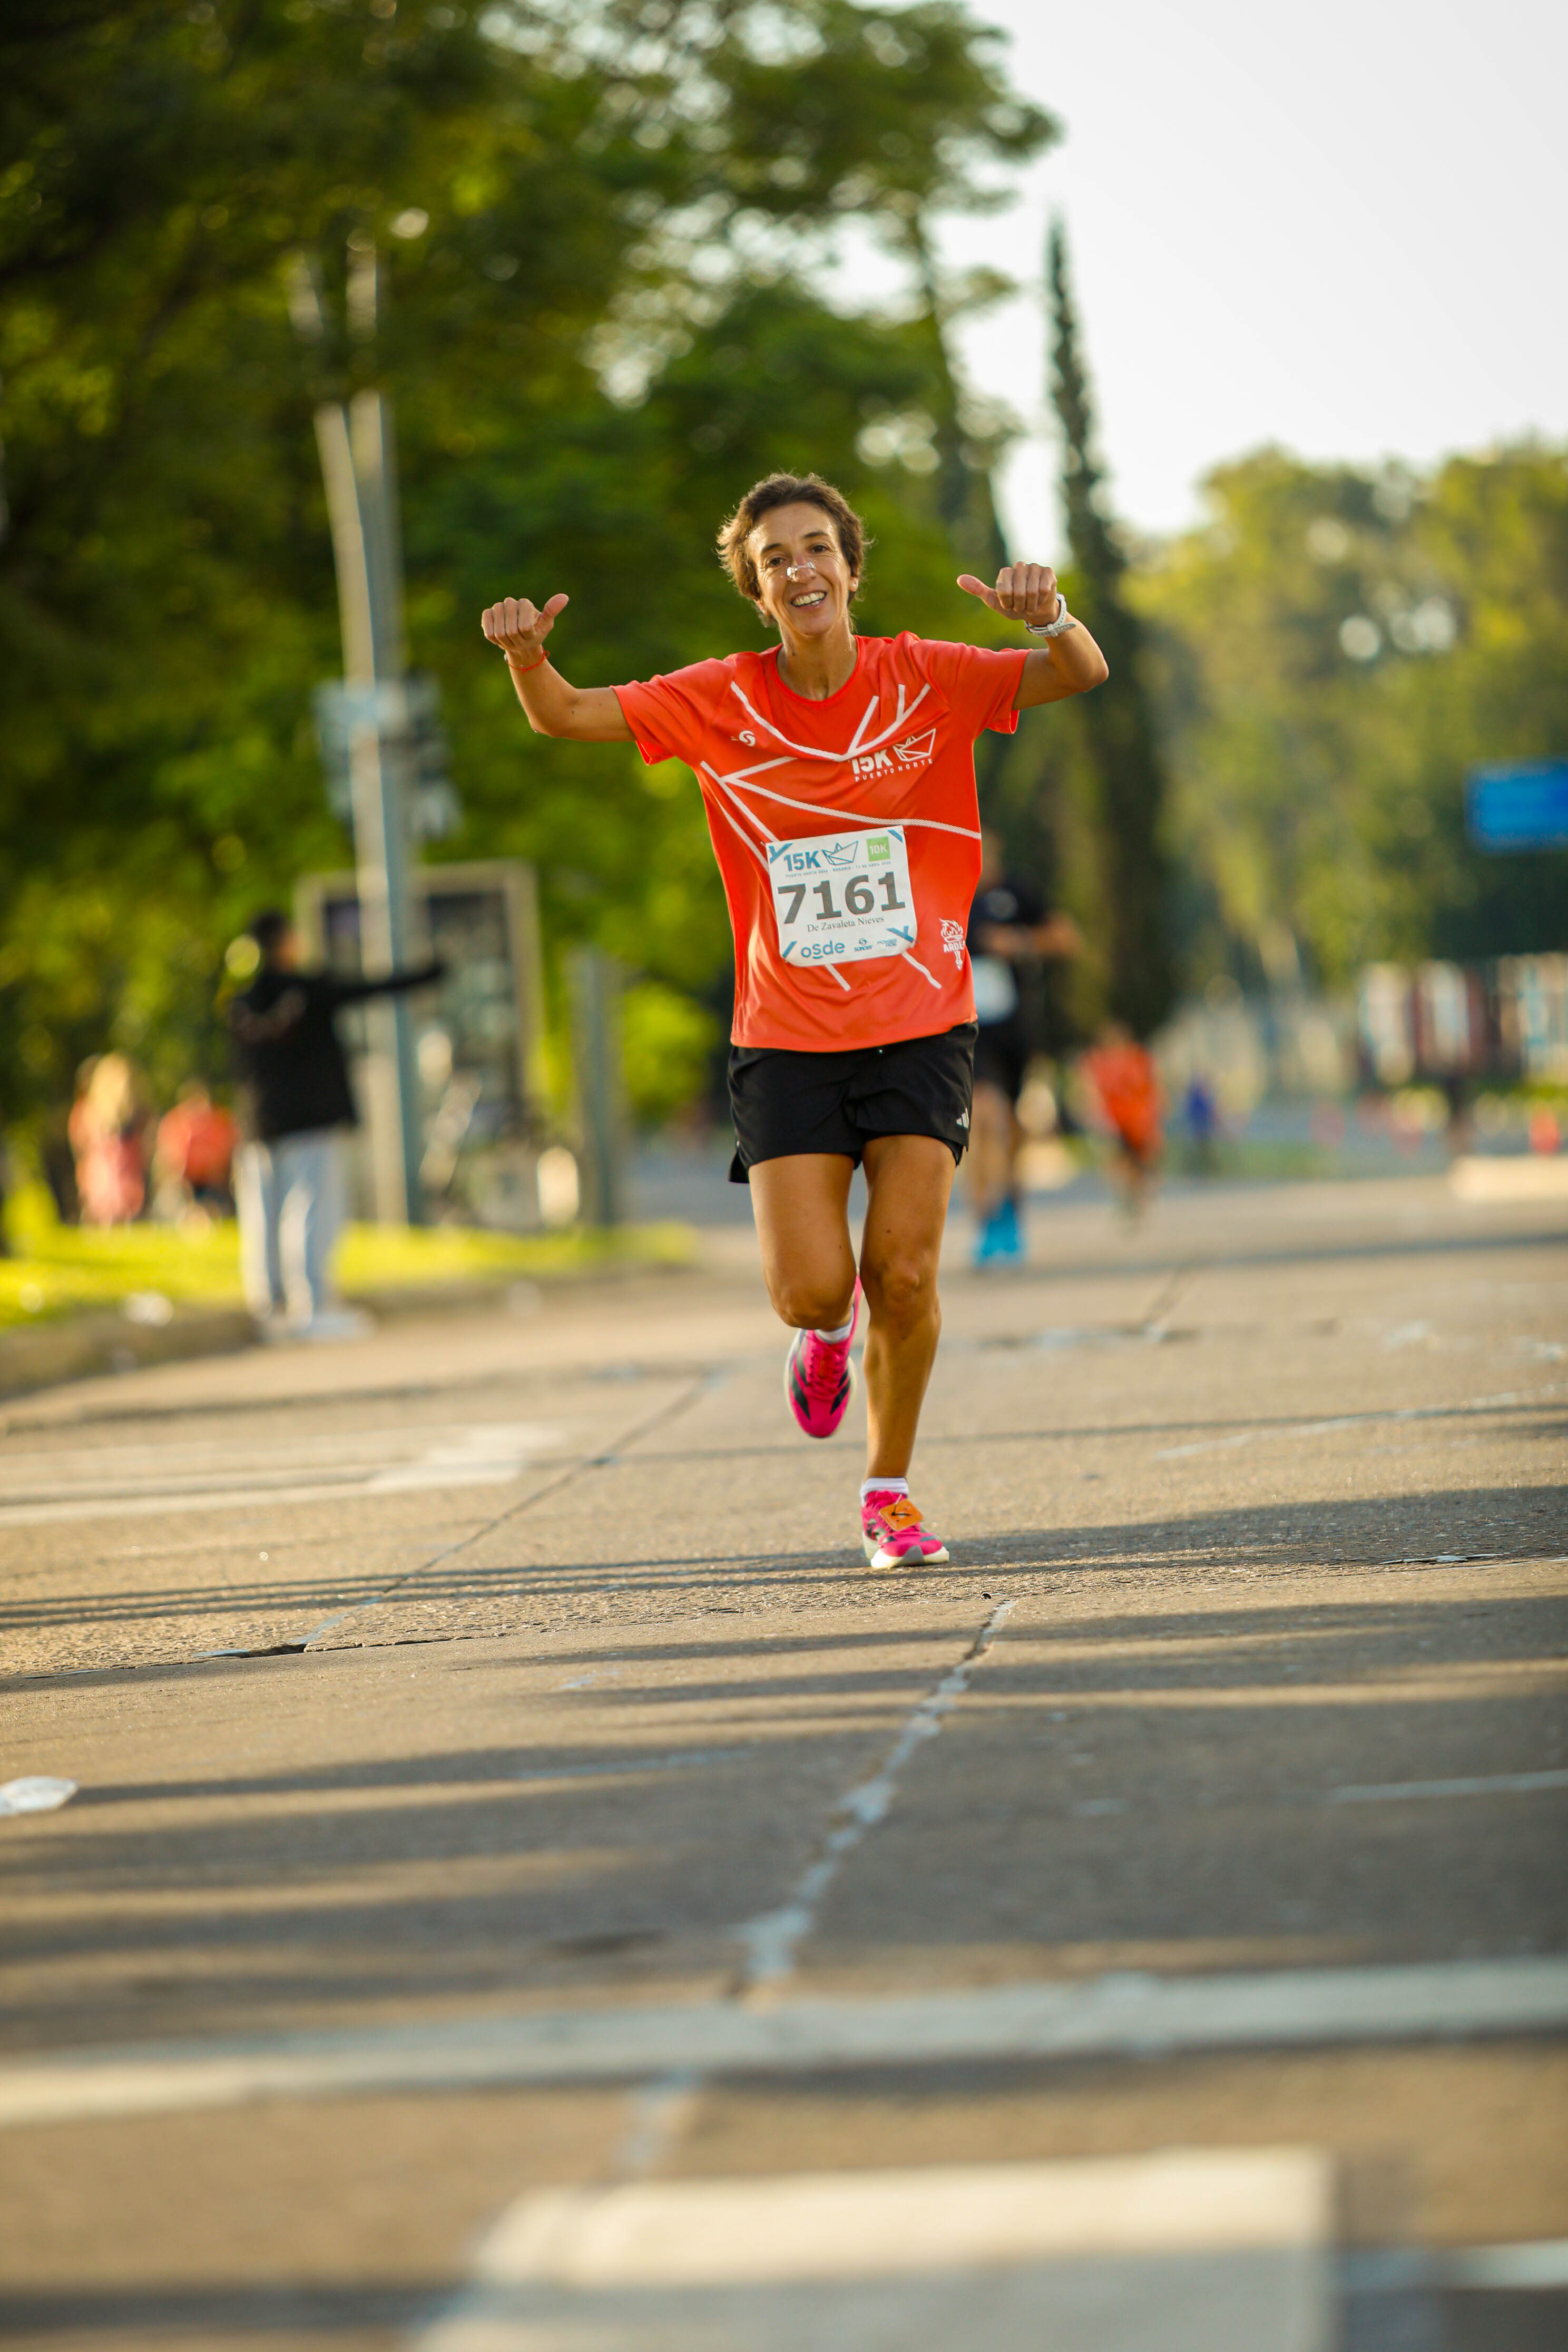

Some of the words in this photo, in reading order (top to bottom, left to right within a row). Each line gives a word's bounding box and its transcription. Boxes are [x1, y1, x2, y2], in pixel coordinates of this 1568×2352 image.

[851, 749, 893, 774] 15K
[869, 844, 888, 854] 10K
[783, 850, 821, 871] 15K
[778, 871, 906, 924] 7161
[821, 920, 856, 930] Zavaleta
[857, 916, 885, 925] Nieves
[800, 940, 845, 959] osde
